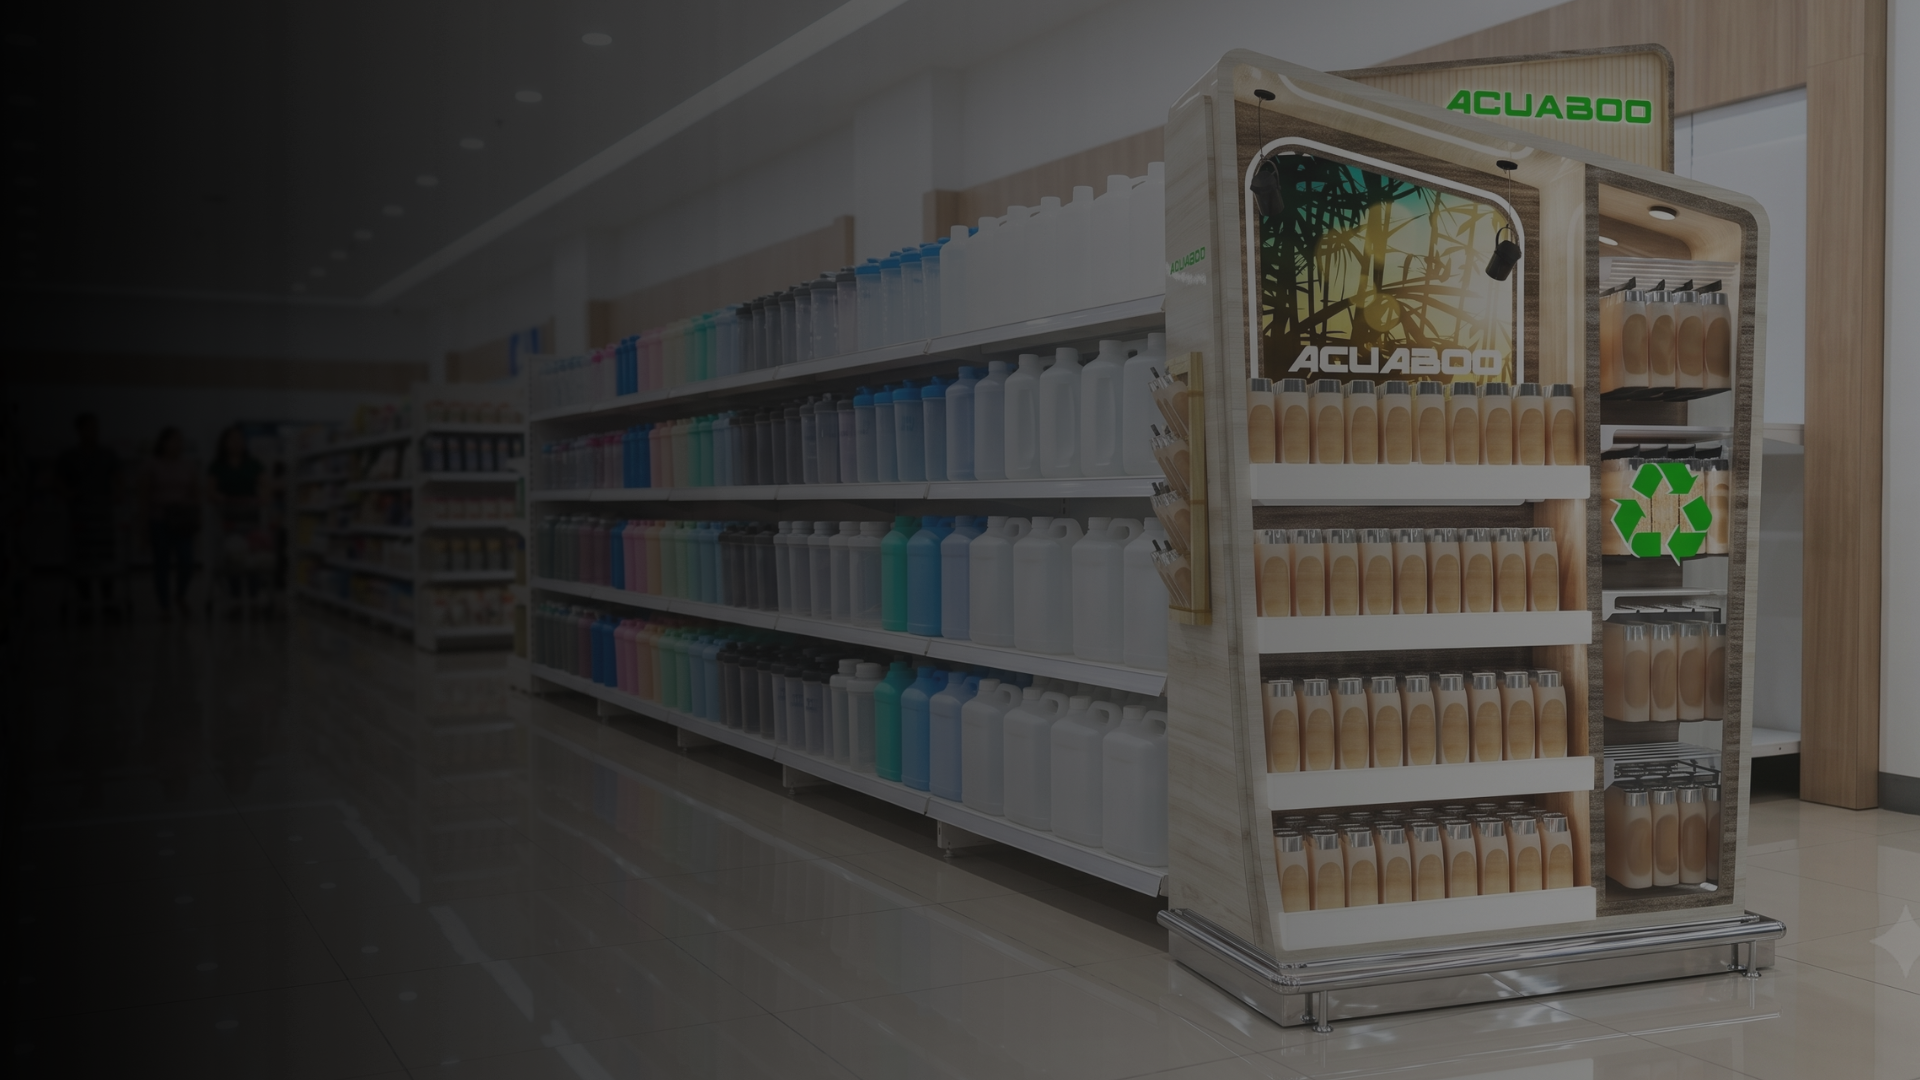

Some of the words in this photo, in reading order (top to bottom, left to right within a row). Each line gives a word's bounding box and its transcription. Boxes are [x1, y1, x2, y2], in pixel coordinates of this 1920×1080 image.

[1446, 89, 1652, 124] ACUABOO
[1170, 246, 1206, 275] ACUABOO
[1287, 345, 1503, 376] ACUABOO
